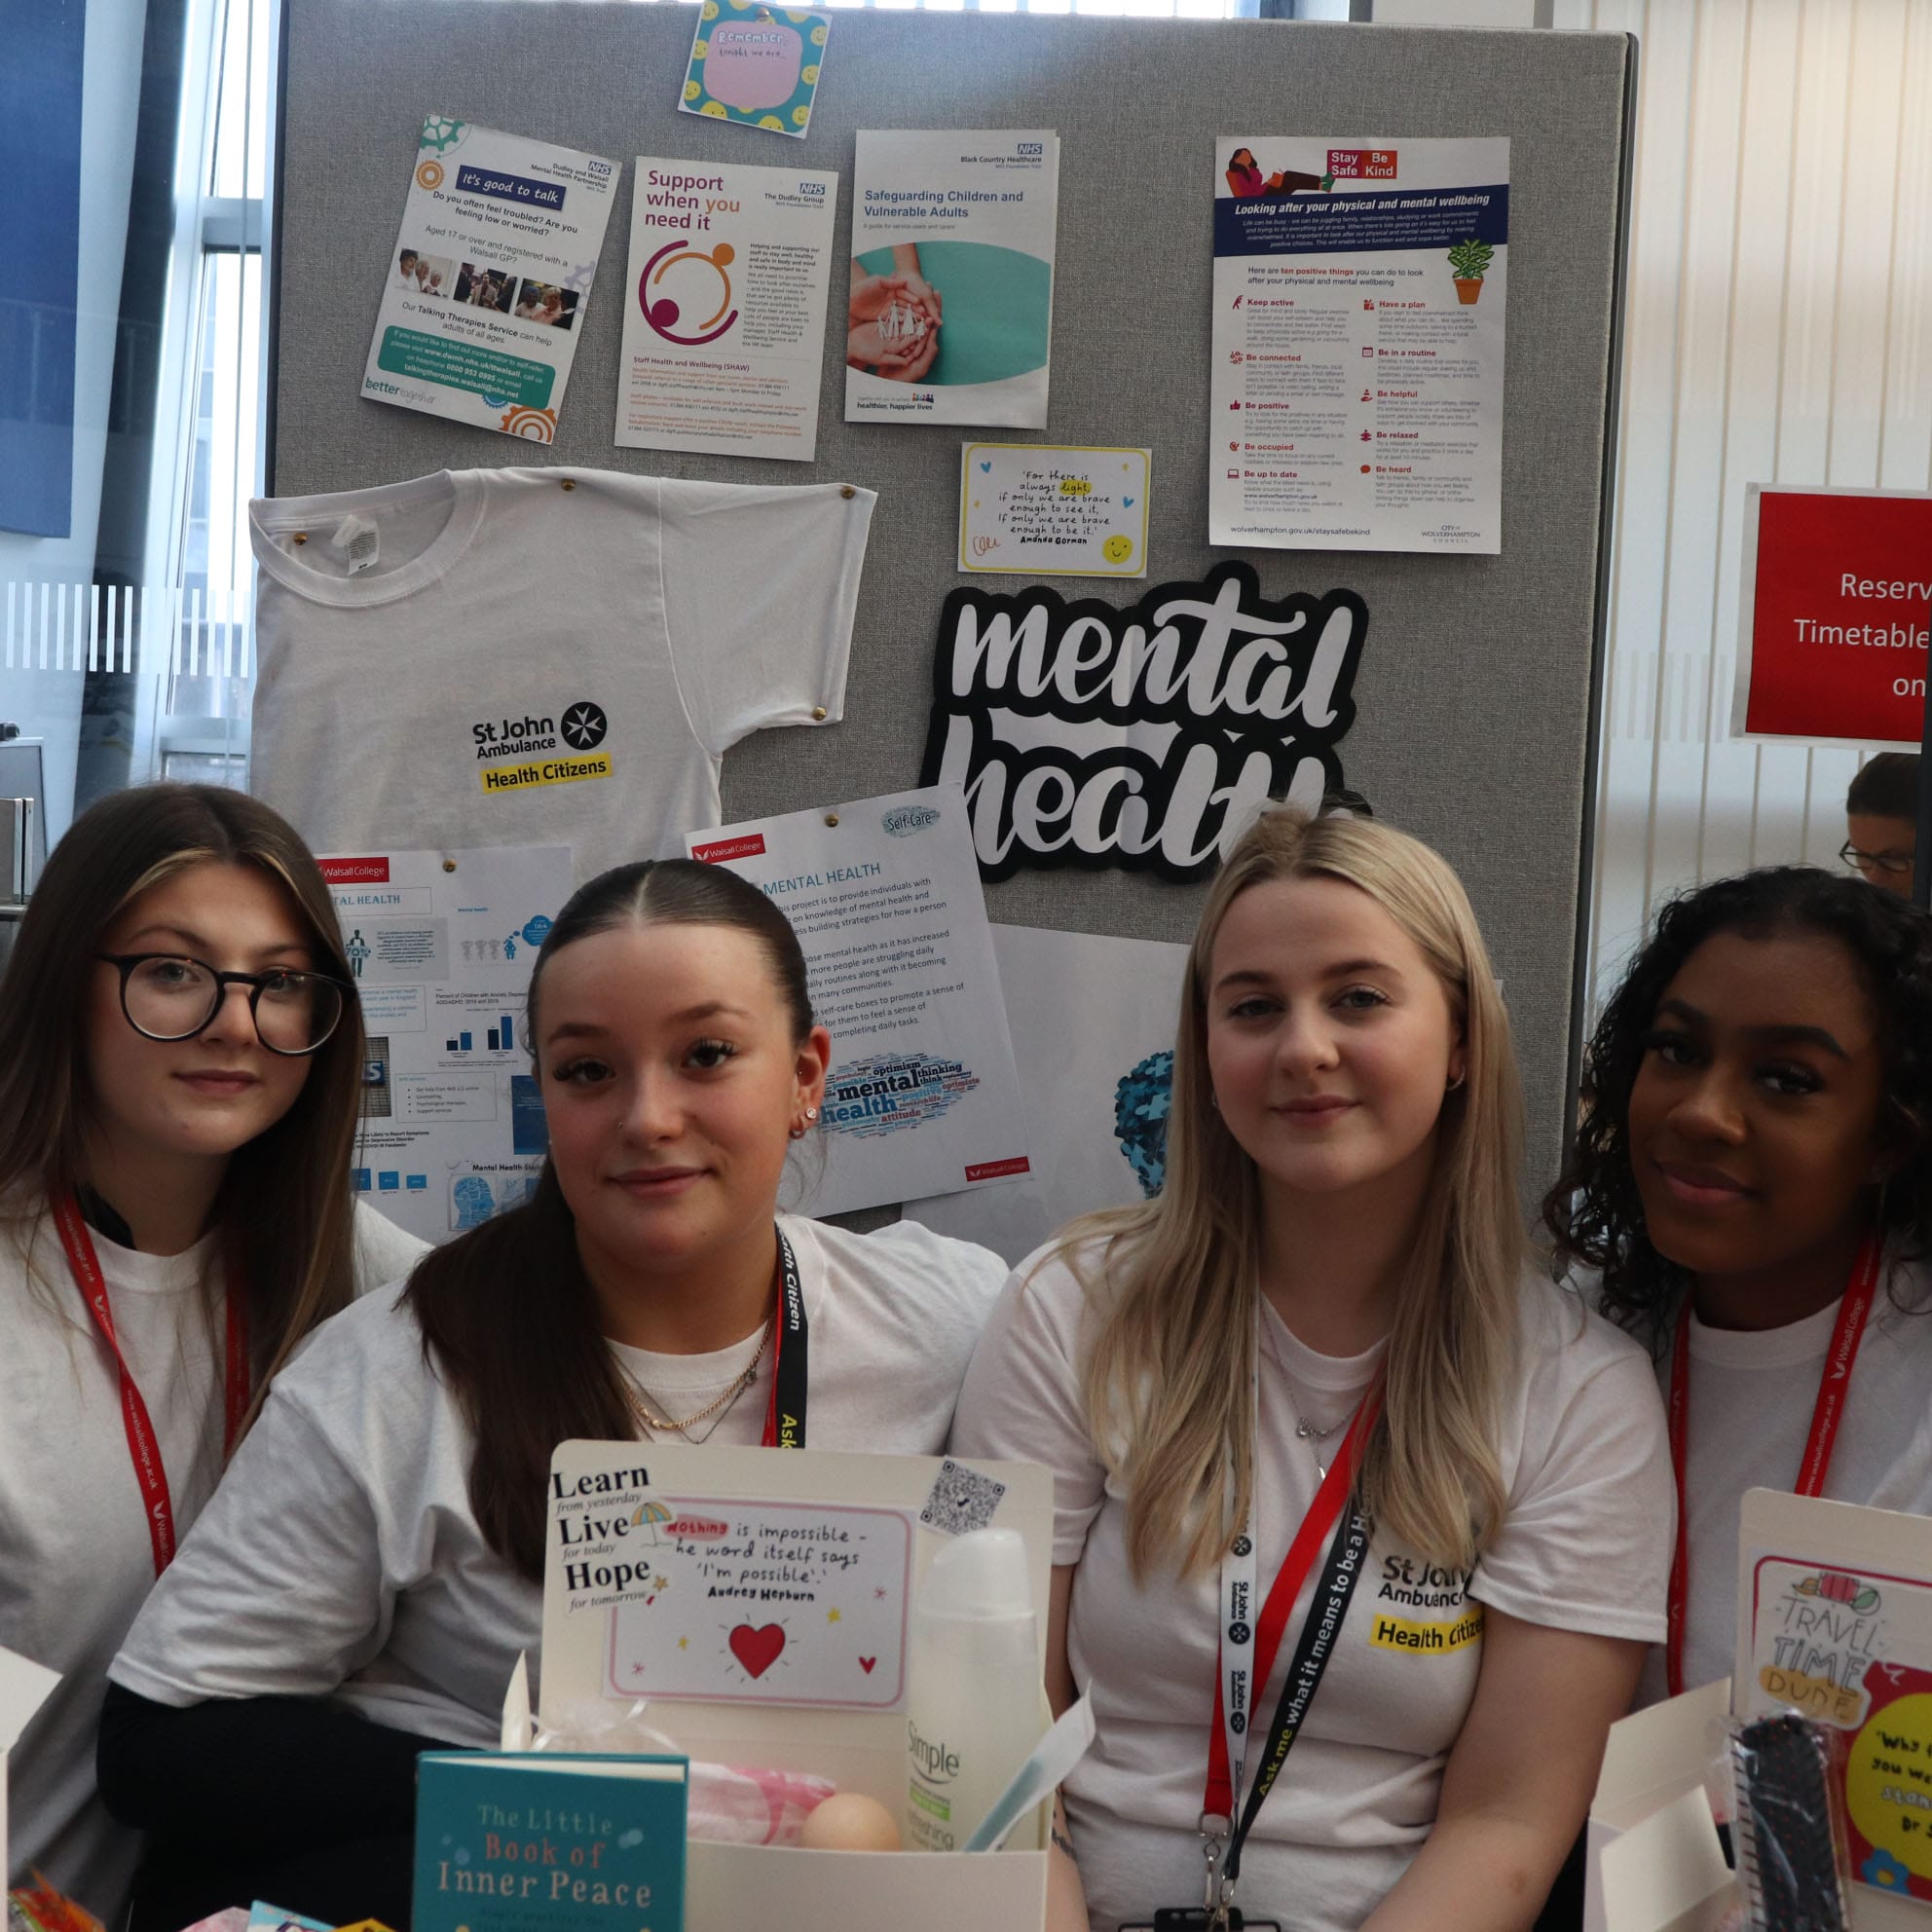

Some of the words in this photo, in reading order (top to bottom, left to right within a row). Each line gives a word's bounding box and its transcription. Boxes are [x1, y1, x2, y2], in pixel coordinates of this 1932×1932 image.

[719, 31, 784, 44] Remember
[1019, 144, 1042, 154] NHS
[1331, 152, 1357, 165] Stay
[1372, 153, 1388, 163] Be
[588, 161, 612, 175] NHS
[1331, 166, 1357, 175] Safe
[1365, 166, 1393, 176] Kind
[463, 173, 481, 186] It's
[482, 180, 514, 193] good
[517, 184, 530, 196] to
[534, 188, 558, 203] talk
[648, 169, 724, 192] Support
[800, 183, 825, 195] NHS
[647, 192, 699, 210] when
[705, 199, 739, 214] you
[778, 194, 801, 203] Dudley
[802, 196, 824, 204] Group
[865, 190, 944, 204] Safeguarding
[947, 190, 997, 202] Children
[1001, 191, 1023, 202] and
[1235, 203, 1277, 215] Looking
[1278, 202, 1304, 212] after
[1306, 203, 1330, 213] your
[1331, 199, 1376, 212] physical
[1377, 198, 1398, 209] and
[1399, 196, 1436, 208] mental
[1439, 194, 1490, 206] wellbeing
[432, 190, 445, 200] Do
[446, 195, 462, 204] you
[463, 199, 484, 209] often
[486, 204, 502, 213] feel
[502, 207, 544, 223] troubled?
[544, 218, 560, 229] Are
[561, 224, 577, 233] you
[455, 206, 483, 221] feeling
[484, 213, 500, 224] low
[512, 222, 549, 236] worried?
[645, 212, 690, 229] need
[697, 213, 710, 231] it
[864, 205, 927, 217] Vulnerable
[929, 206, 968, 217] Adults
[688, 360, 723, 371] Wellbeing
[724, 363, 750, 372] (SHAW)
[1022, 470, 1044, 479] 'For
[1050, 469, 1075, 480] there
[999, 493, 1007, 502] if
[1013, 493, 1033, 503] only
[1083, 494, 1110, 502] brave
[1021, 483, 1056, 495] always
[1060, 483, 1091, 495] light,
[998, 514, 1008, 523] If
[1012, 514, 1033, 524] only
[1083, 515, 1110, 524] brave
[1010, 503, 1046, 515] enough
[1089, 505, 1098, 514] it,
[1794, 619, 1929, 649] Timetable
[952, 577, 1353, 728] mental
[472, 723, 498, 744] St
[501, 718, 554, 740] John
[477, 737, 556, 760] Ambulance
[486, 766, 539, 789] Health
[542, 761, 607, 780] Citizens
[887, 811, 933, 832] Self-Care
[710, 848, 734, 858] Walsall
[734, 842, 761, 852] College
[324, 867, 353, 877] Walsall
[354, 866, 385, 876] College
[763, 873, 823, 897] MENTAL
[826, 862, 880, 883] HEALTH
[357, 894, 400, 904] HEALTH
[791, 899, 819, 911] project
[838, 889, 870, 903] provide
[870, 881, 911, 895] individuals
[912, 877, 931, 887] with
[873, 1061, 921, 1077] optimism
[918, 1062, 962, 1077] thinking
[920, 1075, 943, 1085] think
[837, 1069, 920, 1101] mental
[821, 1095, 898, 1124] health
[881, 1109, 921, 1122] attitude
[785, 1272, 800, 1332] Citizen
[1846, 1297, 1864, 1331] College
[1839, 1327, 1855, 1361] Walsall
[782, 1413, 799, 1448] Ask
[552, 1468, 649, 1499] Learn
[556, 1501, 583, 1514] from
[586, 1493, 642, 1509] yesterday
[559, 1514, 628, 1544] Live
[737, 1523, 749, 1537] is
[759, 1525, 849, 1543] impossible
[1351, 1535, 1362, 1546] a
[563, 1546, 579, 1560] for
[583, 1543, 614, 1556] today
[706, 1540, 755, 1558] word
[763, 1541, 814, 1564] itself
[821, 1551, 859, 1568] says
[1337, 1549, 1357, 1572] be
[566, 1561, 650, 1590] Hope
[1383, 1555, 1414, 1585] St
[707, 1585, 757, 1599] Audrey
[760, 1588, 814, 1601] Hepburn
[1330, 1575, 1349, 1594] to
[570, 1599, 586, 1613] for
[591, 1590, 647, 1606] tomorrow
[1312, 1598, 1342, 1657] means
[1378, 1621, 1443, 1648] Health
[1781, 1596, 1880, 1656] TRAVEL
[1301, 1661, 1319, 1677] it
[1774, 1637, 1867, 1697] TIME
[1285, 1679, 1313, 1725] what
[1768, 1672, 1851, 1721] DUDE
[909, 1720, 960, 1777] Simple
[1276, 1729, 1292, 1757] me
[478, 1805, 518, 1828] The
[528, 1808, 613, 1835] Little
[486, 1834, 556, 1865] Book
[570, 1843, 606, 1869] of
[439, 1861, 538, 1897] Inner
[550, 1871, 650, 1908] Peace
